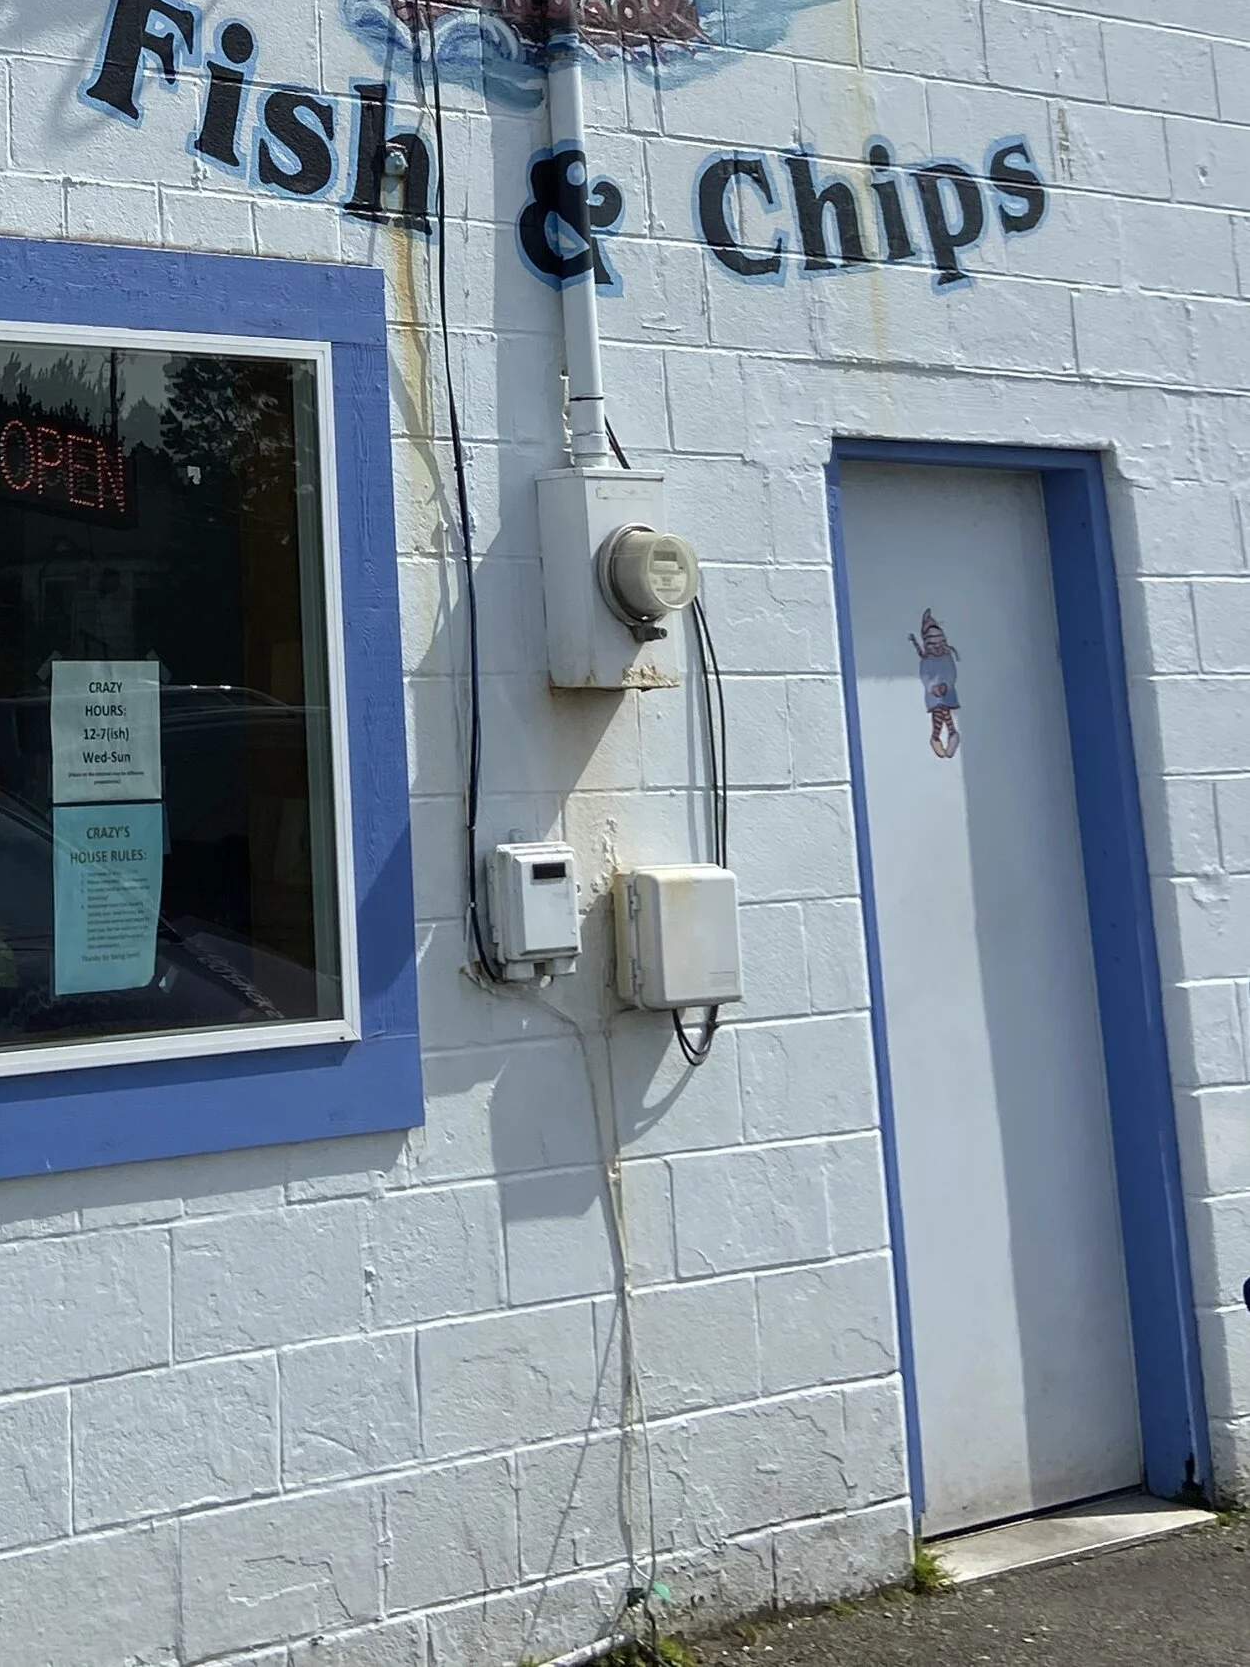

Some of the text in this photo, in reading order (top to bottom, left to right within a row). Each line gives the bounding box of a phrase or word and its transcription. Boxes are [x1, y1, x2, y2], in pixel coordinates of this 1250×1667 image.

[519, 149, 623, 285] &
[698, 142, 1047, 286] Chips
[0, 419, 126, 513] OPEN
[88, 681, 123, 694] CRAZY
[84, 704, 127, 717] HOURS:
[83, 727, 130, 743] 12-7(ish)
[82, 750, 131, 764] Wed-Sun
[86, 825, 131, 840] CRAZY'S
[70, 848, 148, 865] HOUSE RULES:
